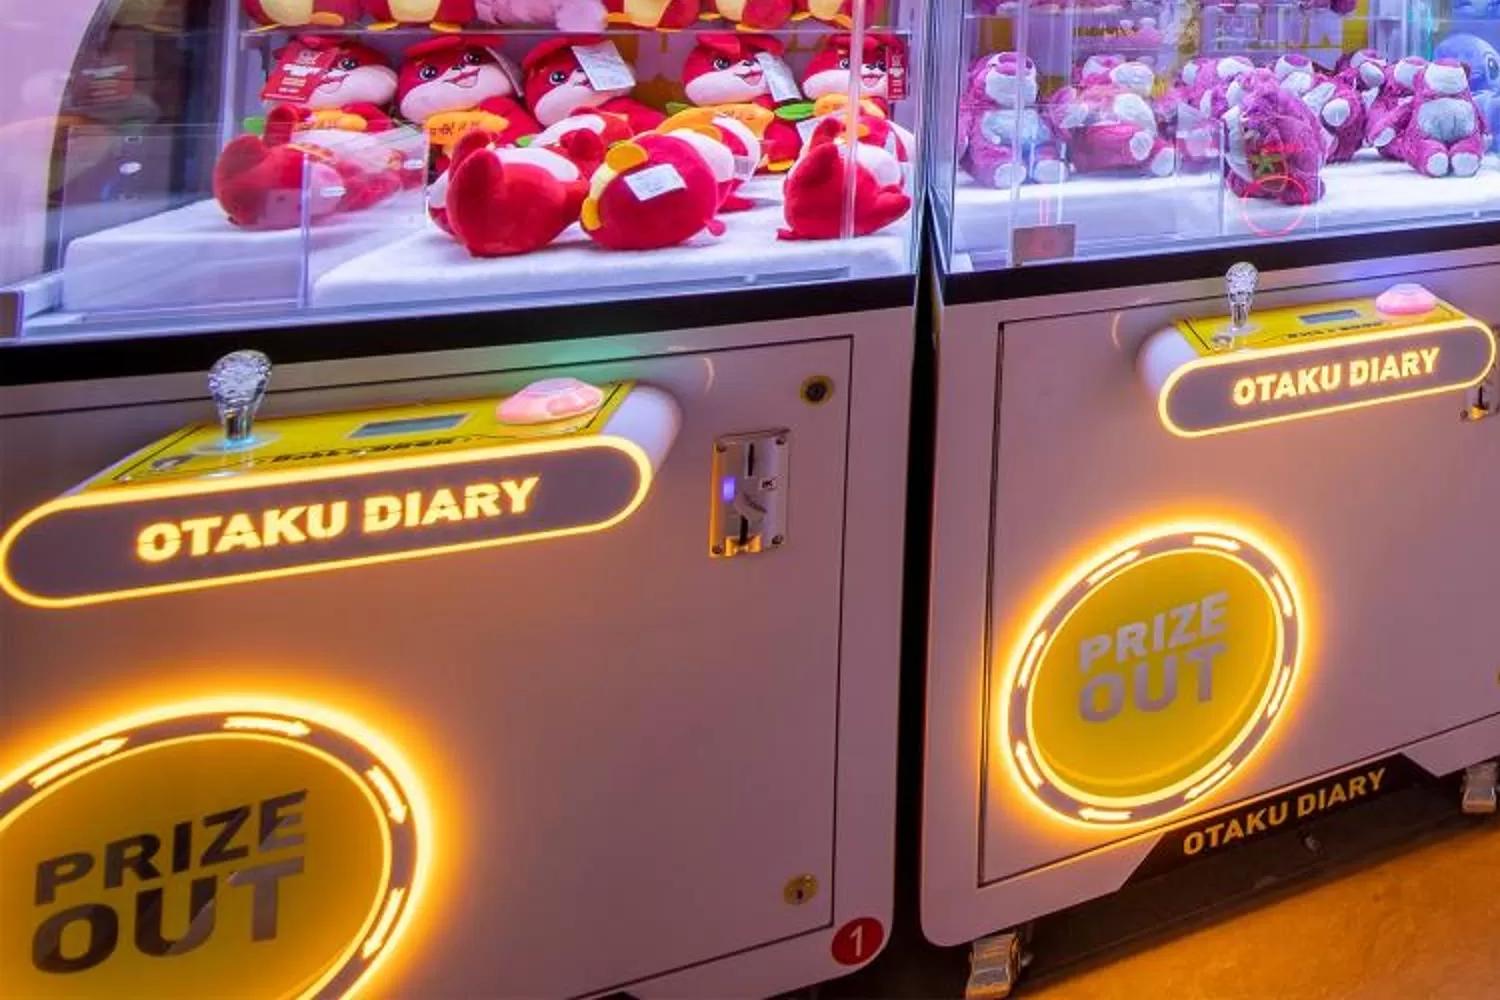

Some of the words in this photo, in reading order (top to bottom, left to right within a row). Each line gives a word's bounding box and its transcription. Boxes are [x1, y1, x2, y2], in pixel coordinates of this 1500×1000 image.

[1232, 363, 1342, 407] OTAKU
[1348, 346, 1441, 389] DIARY
[135, 500, 350, 565] OTAKU
[361, 475, 543, 538] DIARY
[1078, 592, 1232, 675] PRIZE
[1076, 643, 1229, 725] OUT
[34, 789, 310, 907] PRIZE
[1182, 797, 1289, 857] OTAKU
[1296, 767, 1387, 819] DIARY
[30, 855, 305, 976] OUT
[849, 926, 868, 960] 1
